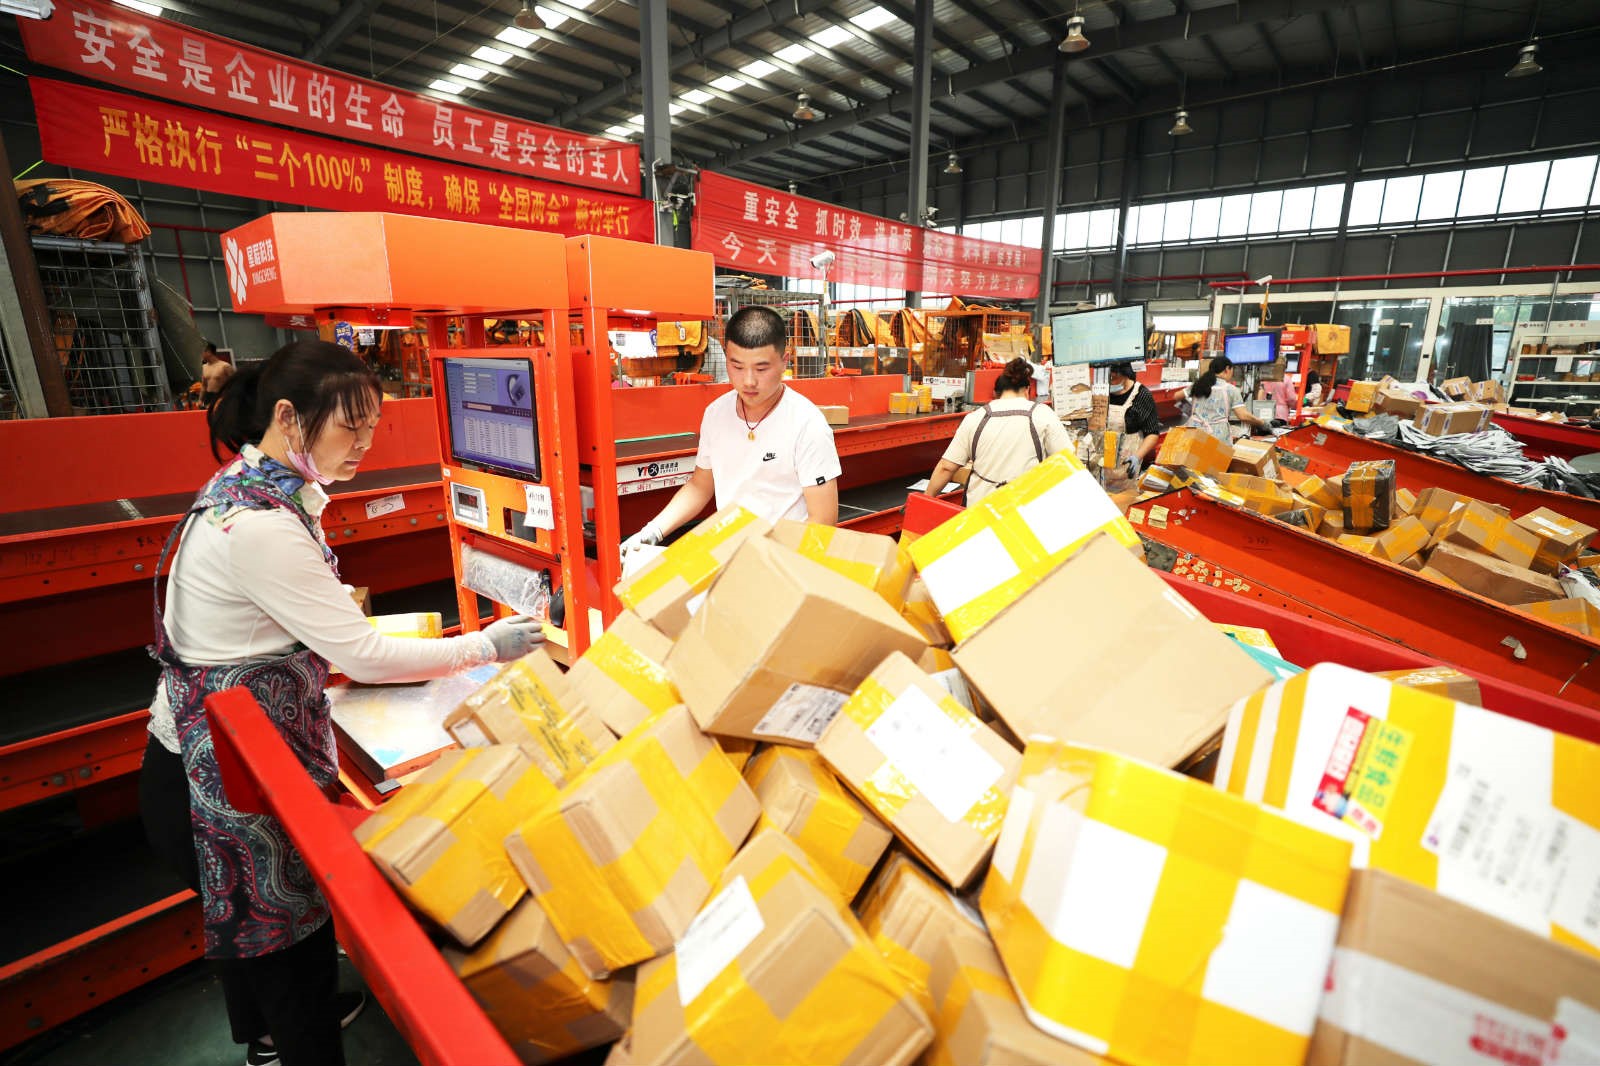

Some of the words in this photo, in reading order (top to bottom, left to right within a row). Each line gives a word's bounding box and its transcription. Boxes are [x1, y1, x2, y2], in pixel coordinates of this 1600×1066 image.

[71, 8, 406, 139] 安全是企业的生命
[431, 103, 630, 185] 员工是安全的主人
[743, 191, 799, 230] 重安全
[815, 207, 862, 242] 抓时效
